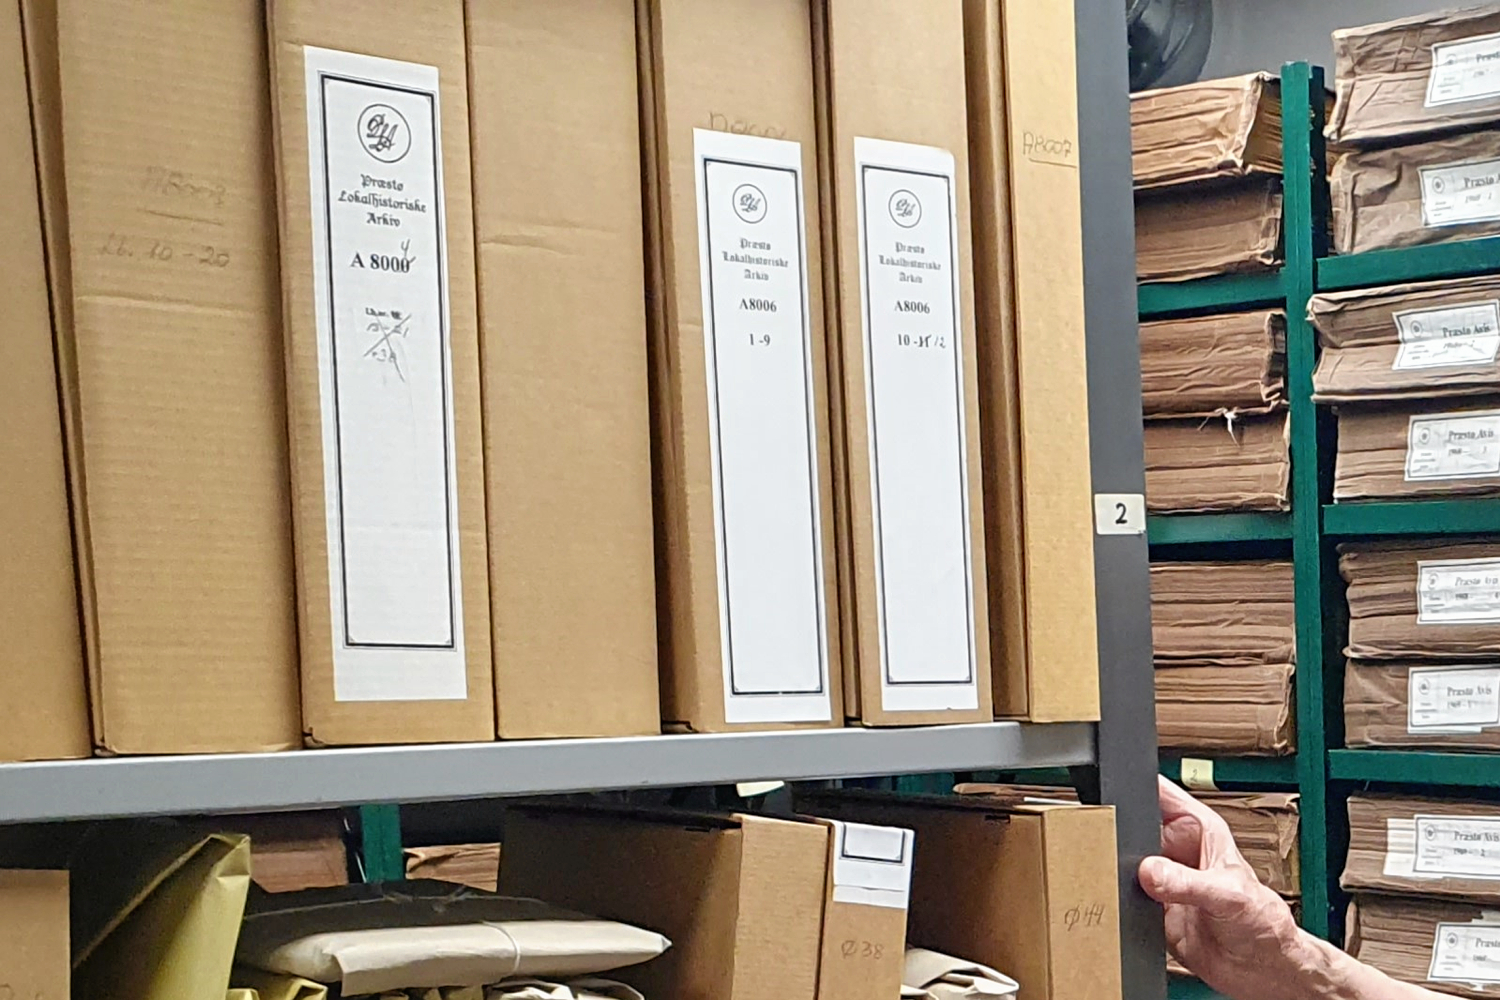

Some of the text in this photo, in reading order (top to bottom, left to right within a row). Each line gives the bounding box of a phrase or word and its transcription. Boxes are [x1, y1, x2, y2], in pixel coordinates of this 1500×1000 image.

[367, 212, 401, 227] Arkiv
[350, 252, 365, 268] A
[739, 299, 777, 312] A8006
[894, 300, 930, 314] A8006
[1115, 502, 1128, 525] 2
